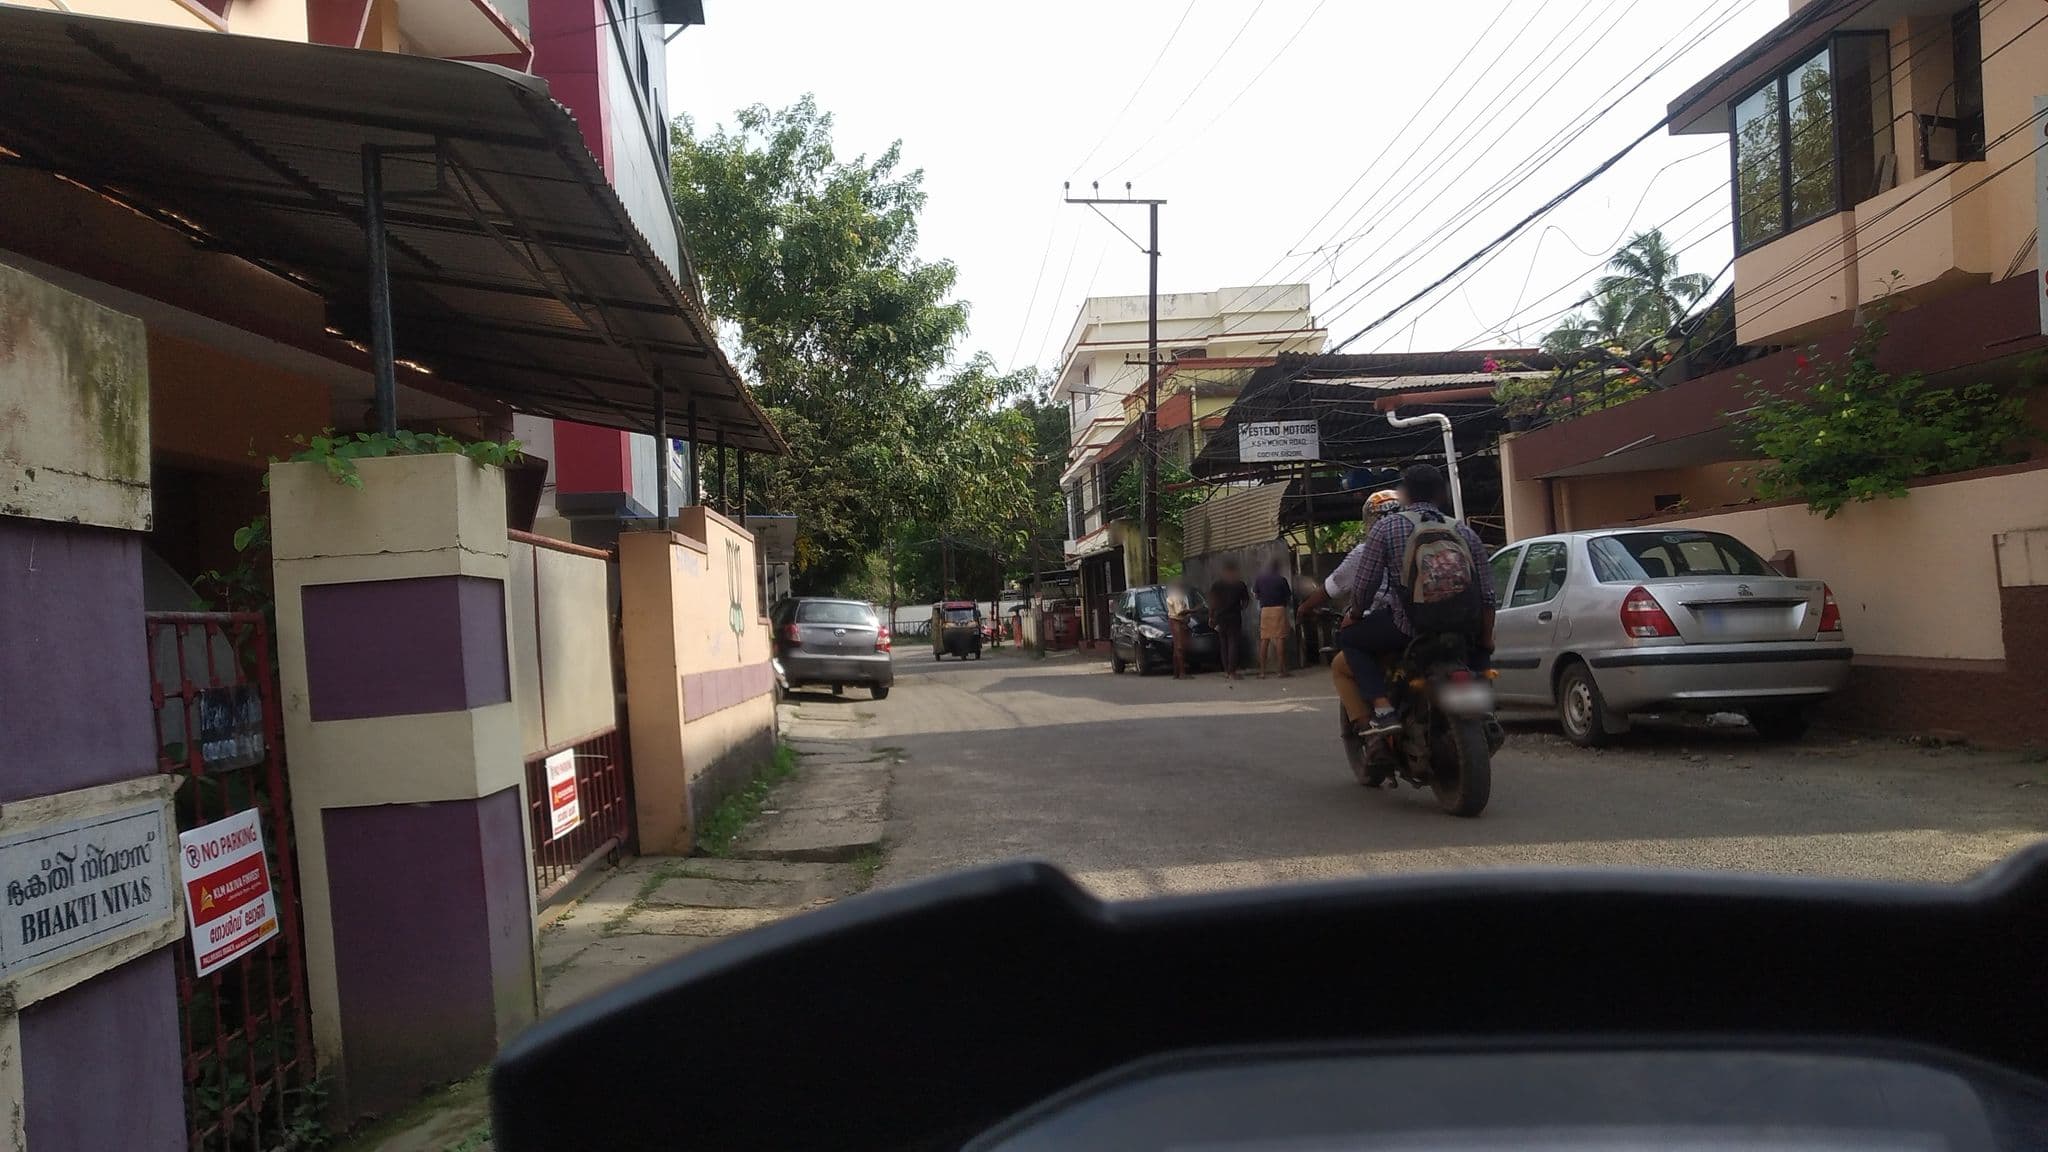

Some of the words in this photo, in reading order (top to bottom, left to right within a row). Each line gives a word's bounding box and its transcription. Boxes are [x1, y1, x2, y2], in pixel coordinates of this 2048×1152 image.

[1240, 425, 1281, 437] WESTEND
[1284, 424, 1317, 436] MOTORS
[81, 831, 155, 883] നിവാസ്
[201, 843, 219, 863] NO
[221, 823, 257, 856] PARKING
[20, 892, 99, 945] BHAKTI
[101, 876, 153, 918] NIVAS
